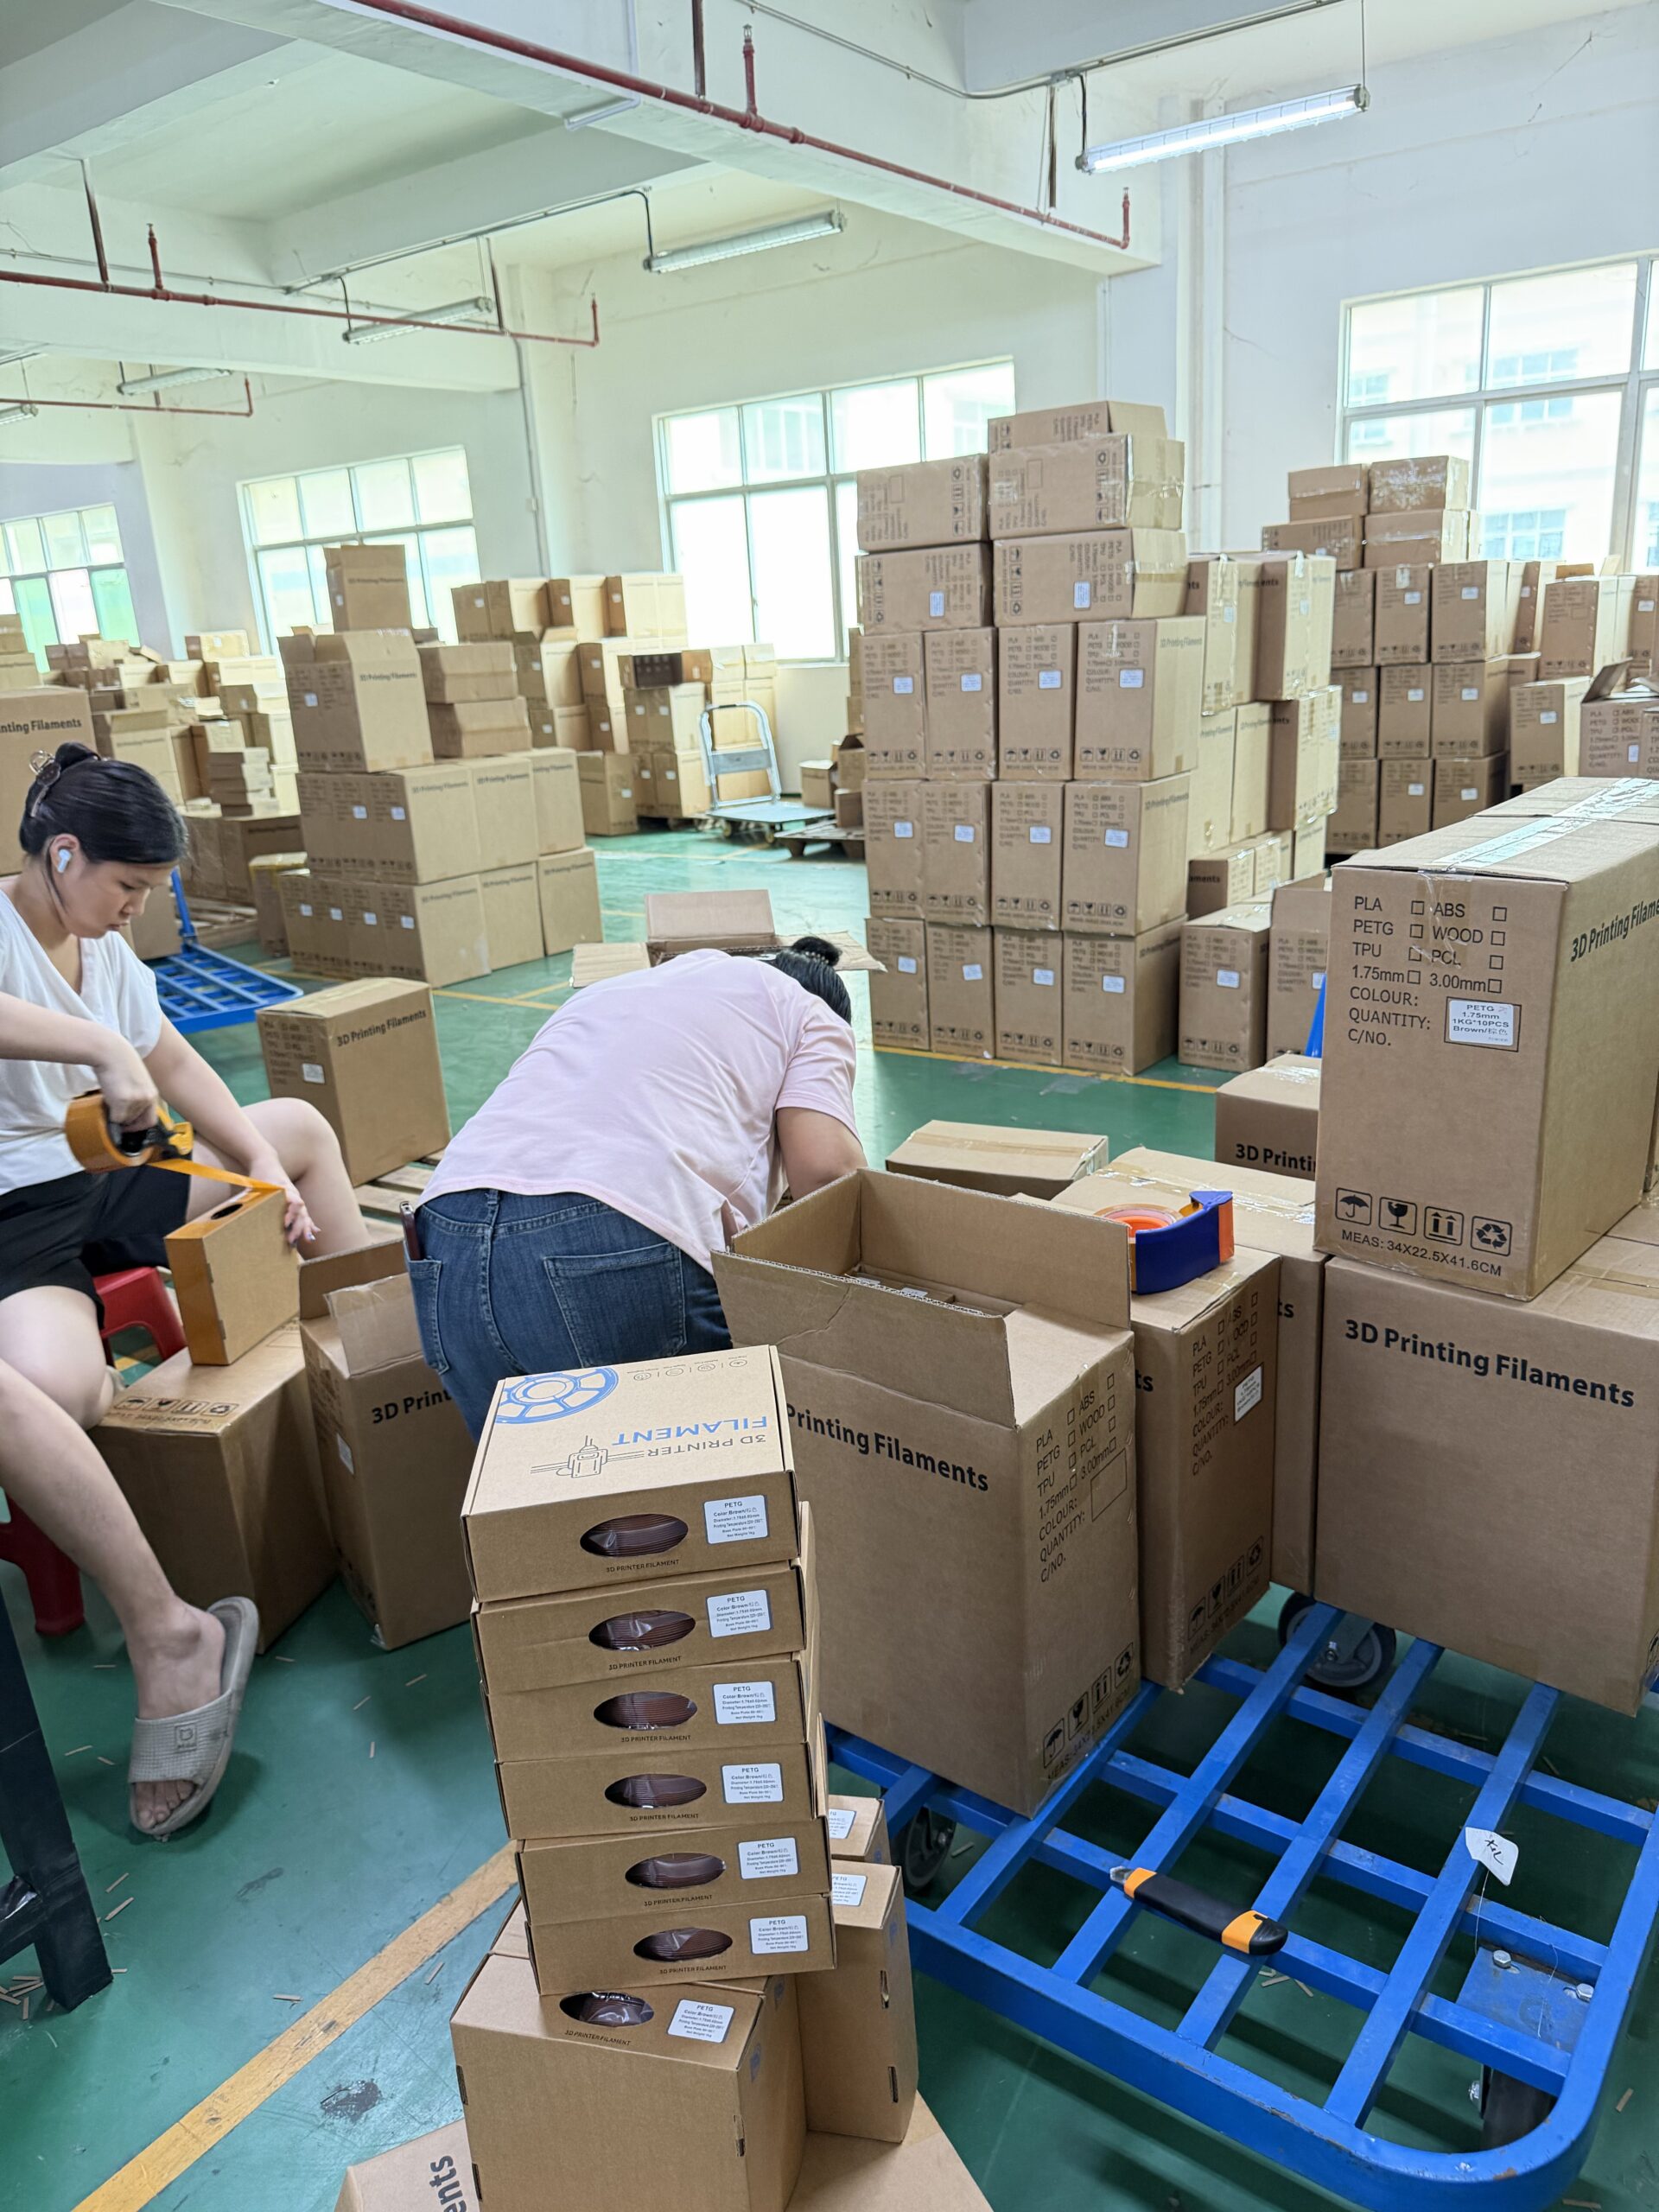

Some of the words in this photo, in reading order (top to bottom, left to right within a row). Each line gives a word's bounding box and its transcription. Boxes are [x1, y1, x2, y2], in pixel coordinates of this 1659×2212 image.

[1354, 895, 1382, 912] PLA
[1433, 902, 1465, 918] ABS
[1353, 918, 1394, 936] PETG
[1433, 925, 1484, 944] WOOD
[1570, 932, 1587, 963] 3D
[1588, 914, 1630, 953] Printing
[1352, 941, 1382, 957] TPU
[1431, 950, 1462, 966] PCL
[1351, 964, 1404, 983] 1.75mm
[1429, 973, 1486, 992] 3.00mm
[1350, 986, 1419, 1007] COLOUR:
[336, 1034, 350, 1047] 3D
[350, 1023, 386, 1042] Printing
[387, 1010, 426, 1030] Filaments
[1349, 1007, 1431, 1031] QUANTITY:
[1348, 1028, 1391, 1046] C/NO.
[1235, 1143, 1259, 1161] 3D
[1341, 1229, 1384, 1249] MEAS:
[1387, 1240, 1502, 1277] 34X22.5X41.6CM
[1192, 1335, 1207, 1357] PLA
[1192, 1351, 1211, 1378] PETG
[1345, 1319, 1379, 1344] 3D
[1383, 1327, 1490, 1377] Printing
[1496, 1353, 1636, 1408] Filaments
[1192, 1375, 1207, 1397] TPU
[372, 1402, 399, 1424] 3D
[1036, 1428, 1053, 1453] PLA
[1078, 1390, 1095, 1415] ABS
[1192, 1401, 1224, 1438] COLOUR:
[612, 1416, 767, 1446] FILAMENT
[740, 1434, 766, 1444] 3D
[1037, 1445, 1060, 1477] PETG
[1078, 1404, 1105, 1436] WOOD
[1192, 1414, 1229, 1457] QUANTITY:
[648, 1438, 733, 1457] PRINTER
[874, 1432, 989, 1492] Filaments
[1038, 1471, 1055, 1497] TPU
[1080, 1436, 1096, 1459] PCL
[1039, 1484, 1069, 1520] 1.75mm
[1081, 1446, 1109, 1480] 3.00mm
[1039, 1497, 1077, 1541] COLOUR:
[1039, 1510, 1085, 1563] QUANTITY:
[616, 1563, 645, 1572] PRINTER
[645, 1559, 680, 1568] FILAMENT
[1040, 1552, 1066, 1583] C/NO.
[619, 1661, 647, 1669] PRINTER
[649, 1656, 682, 1666] FILAMENT
[653, 1897, 680, 1906] PRINTER
[574, 2031, 600, 2040] PRINTER
[600, 2036, 632, 2046] FILAMENT
